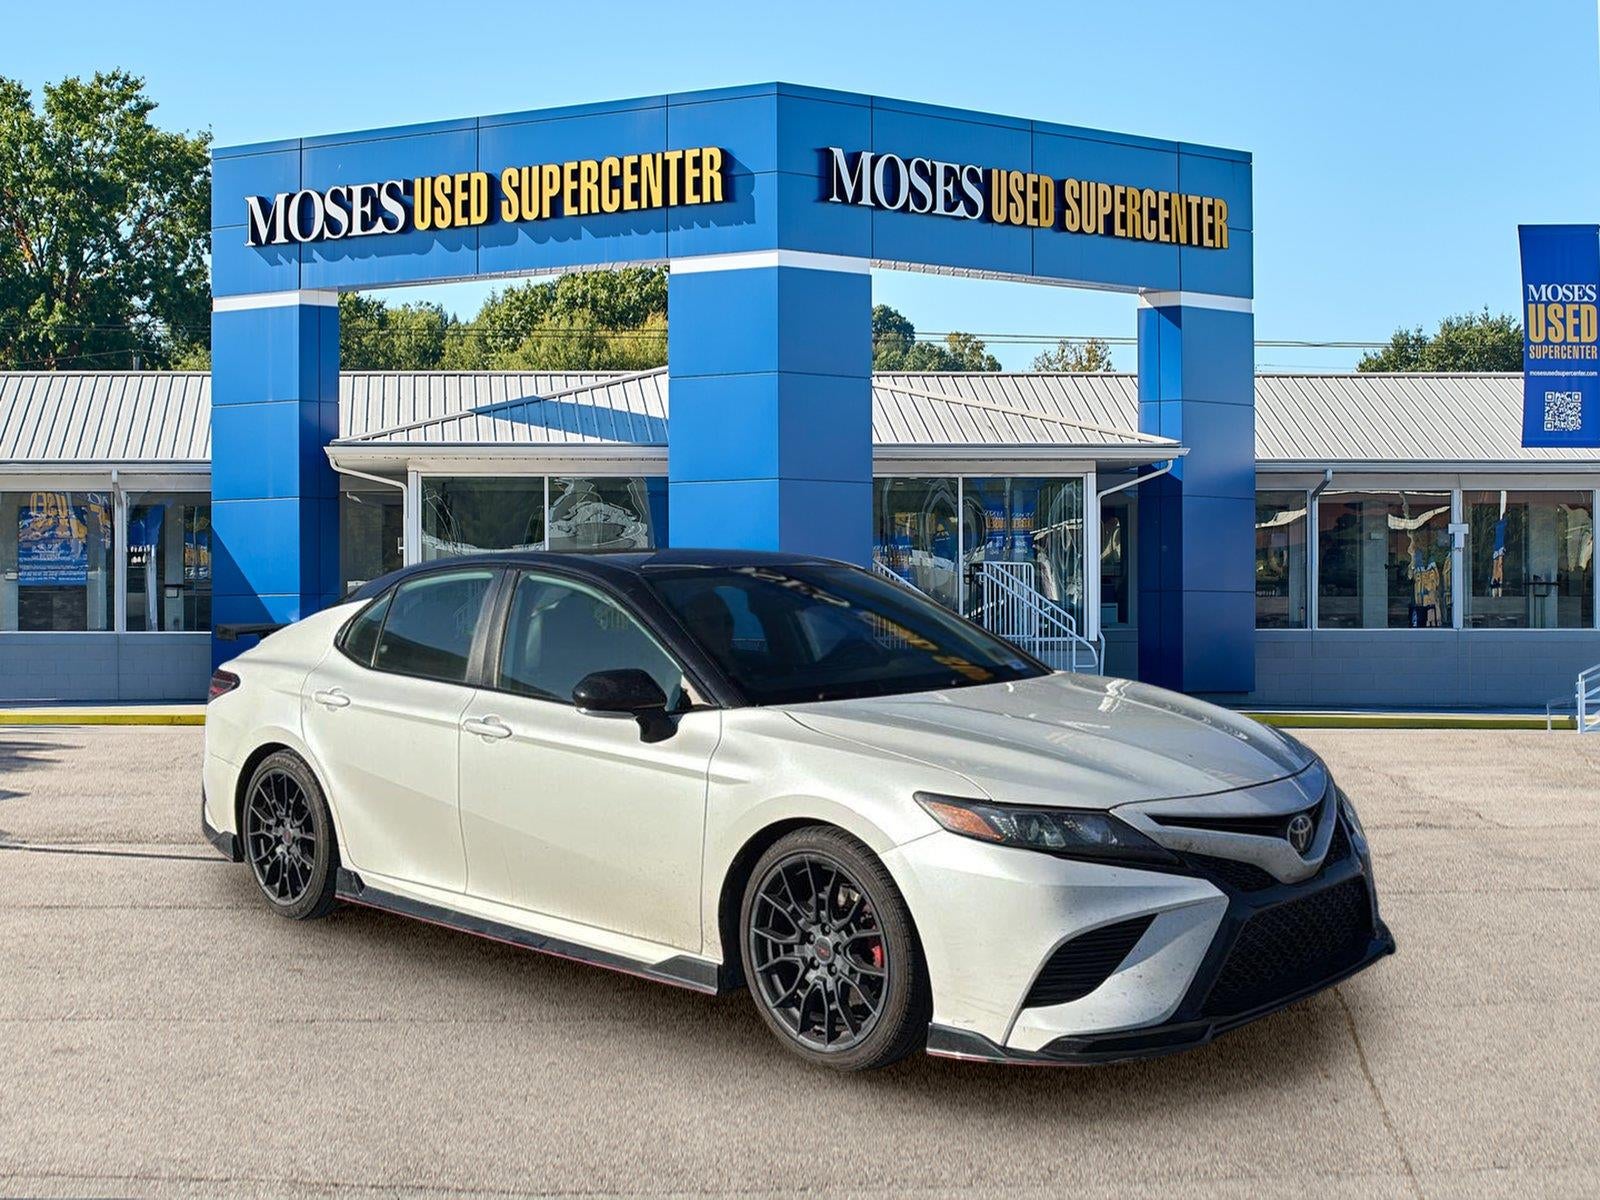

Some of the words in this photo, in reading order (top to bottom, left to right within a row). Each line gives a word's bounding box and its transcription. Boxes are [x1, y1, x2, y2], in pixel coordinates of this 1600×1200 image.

[243, 179, 407, 247] MOSES
[413, 171, 489, 231] USED
[500, 146, 724, 223] SUPERCENTER
[828, 147, 985, 219] MOSES
[991, 168, 1055, 228] USED
[1065, 177, 1229, 249] SUPERCENTER
[1527, 283, 1597, 302] MOSES
[1528, 303, 1598, 343] USED
[1529, 344, 1598, 360] SUPERCENTER
